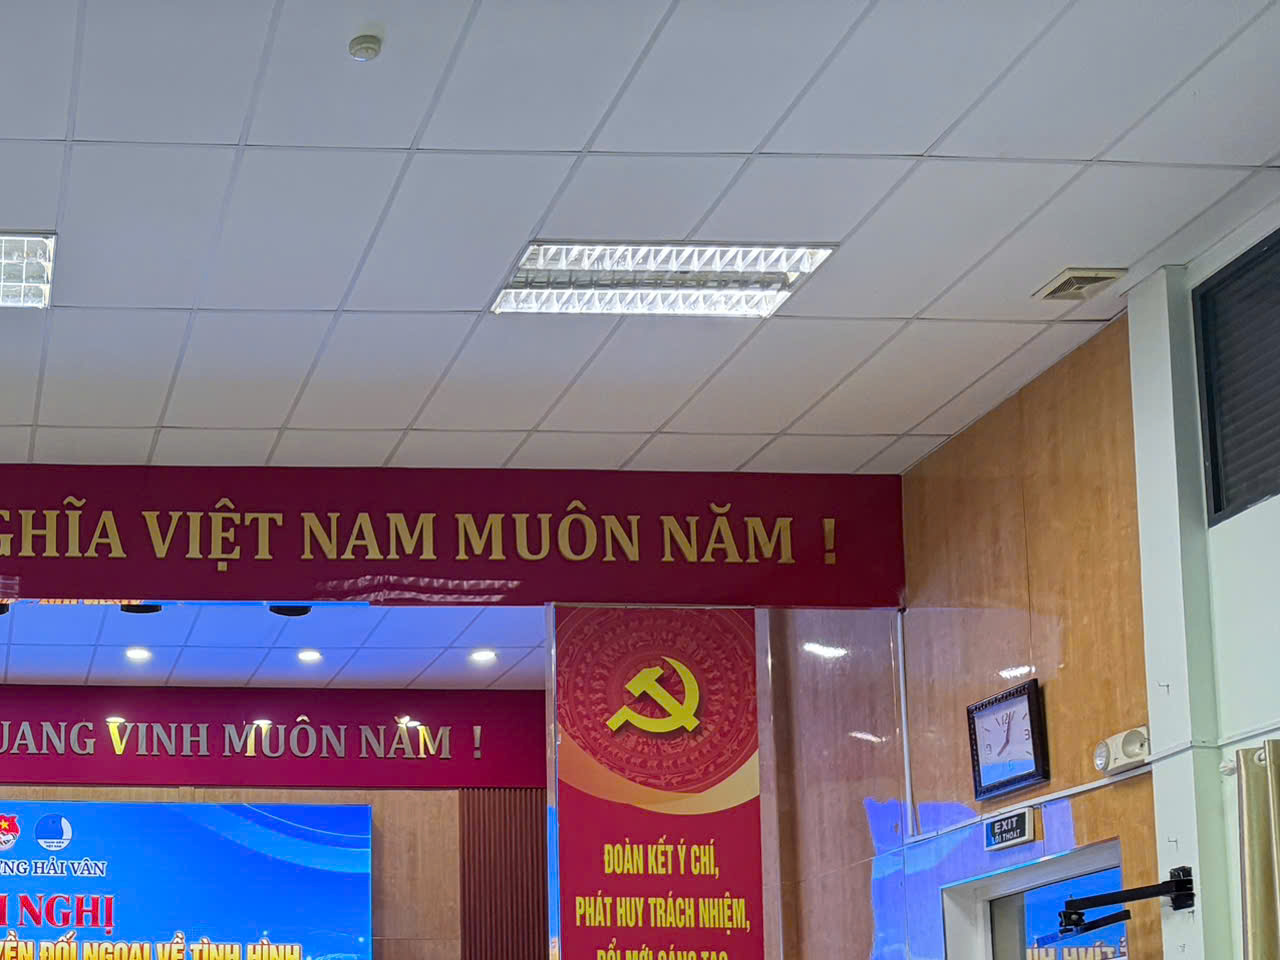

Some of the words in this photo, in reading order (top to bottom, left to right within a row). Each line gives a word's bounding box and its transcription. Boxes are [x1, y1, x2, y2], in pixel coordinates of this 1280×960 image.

[141, 498, 284, 572] VIỆT
[301, 511, 435, 562] NAM
[456, 501, 641, 565] MUÔN
[662, 504, 794, 566] NĂM
[822, 518, 836, 565] !
[107, 721, 208, 756] VINH
[222, 715, 347, 758] MUÔN
[360, 716, 452, 759] NĂM
[473, 725, 482, 758] !
[995, 817, 1018, 832] EXIT
[32, 856, 67, 876] HẢI
[69, 858, 107, 877] VÂN
[604, 837, 644, 874] ĐOÀN
[648, 834, 675, 874] KẾT
[677, 838, 687, 874] Ý
[690, 838, 720, 879] CHÍ,
[17, 893, 115, 935] NGHỊ
[575, 889, 613, 927] PHÁT
[616, 897, 645, 927] HUY
[648, 890, 695, 928] TRÁCH
[698, 891, 751, 935] NHIỆM,
